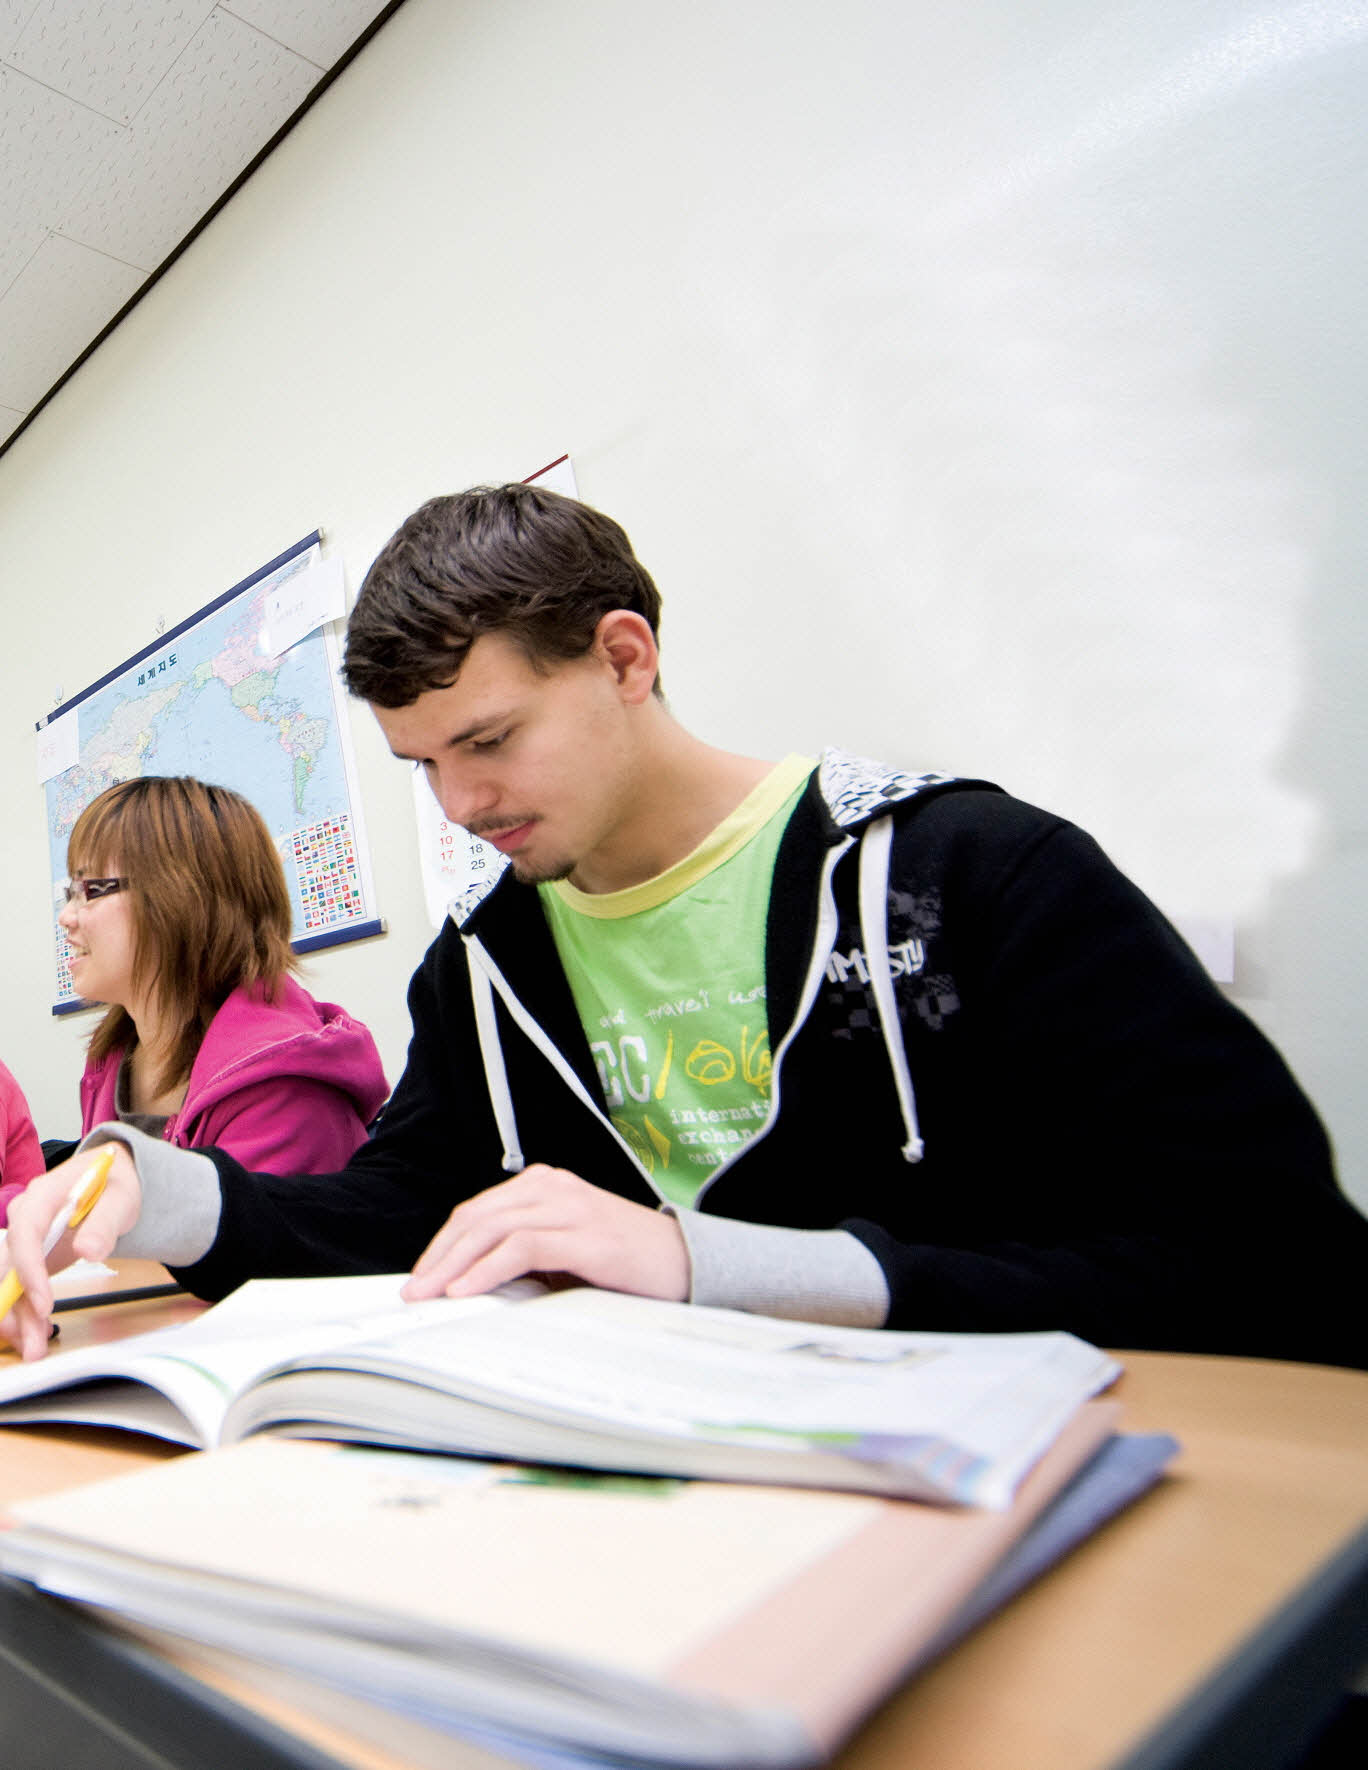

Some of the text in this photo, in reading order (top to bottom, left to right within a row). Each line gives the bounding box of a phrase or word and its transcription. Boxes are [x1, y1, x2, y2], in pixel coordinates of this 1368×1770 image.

[137, 653, 177, 687] 세계지도
[440, 822, 448, 831] 3
[440, 836, 453, 846] 10
[441, 844, 484, 860] 17 18
[471, 859, 486, 870] 25
[645, 989, 710, 1025] travel
